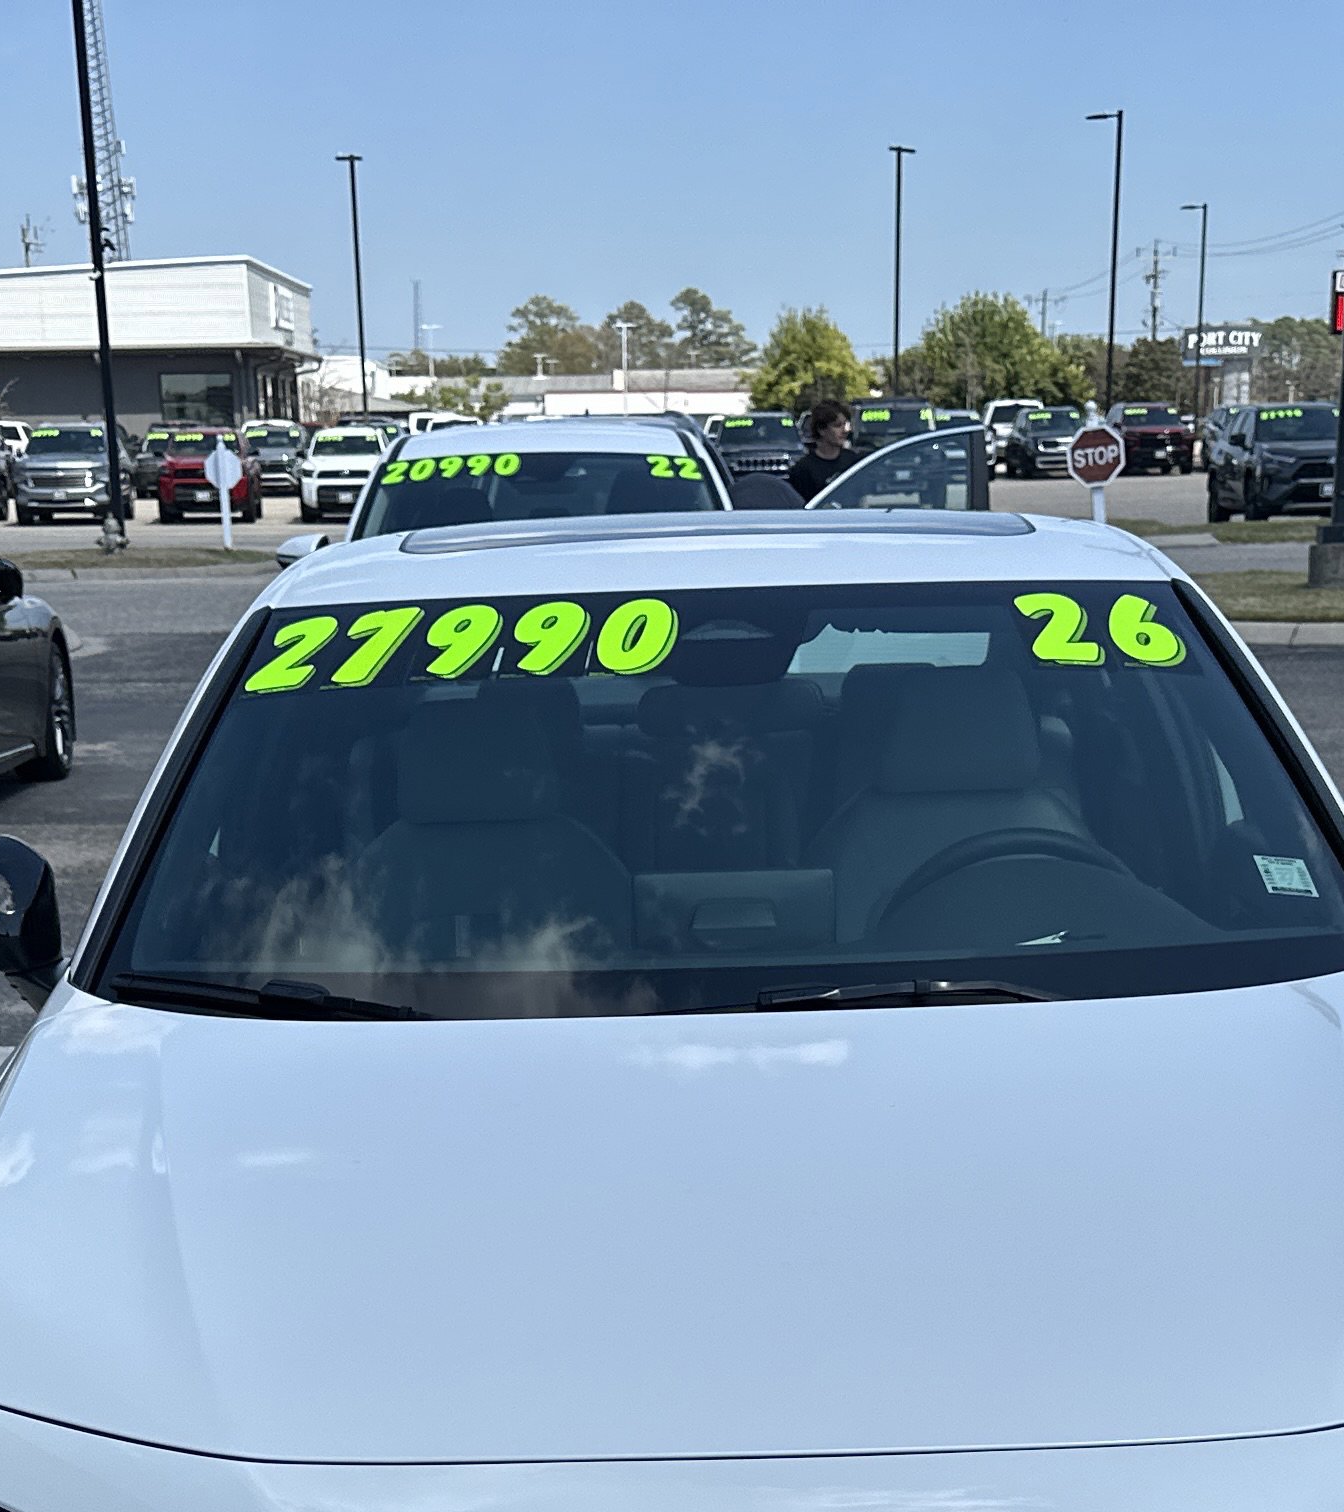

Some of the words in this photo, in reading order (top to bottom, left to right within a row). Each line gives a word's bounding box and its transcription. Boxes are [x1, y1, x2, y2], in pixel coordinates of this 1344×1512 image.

[1228, 330, 1262, 347] CITY
[380, 453, 521, 485] 20990
[646, 455, 704, 481] 22
[1073, 444, 1119, 468] STOP
[243, 598, 679, 693] 27990
[1014, 593, 1186, 667] 26
